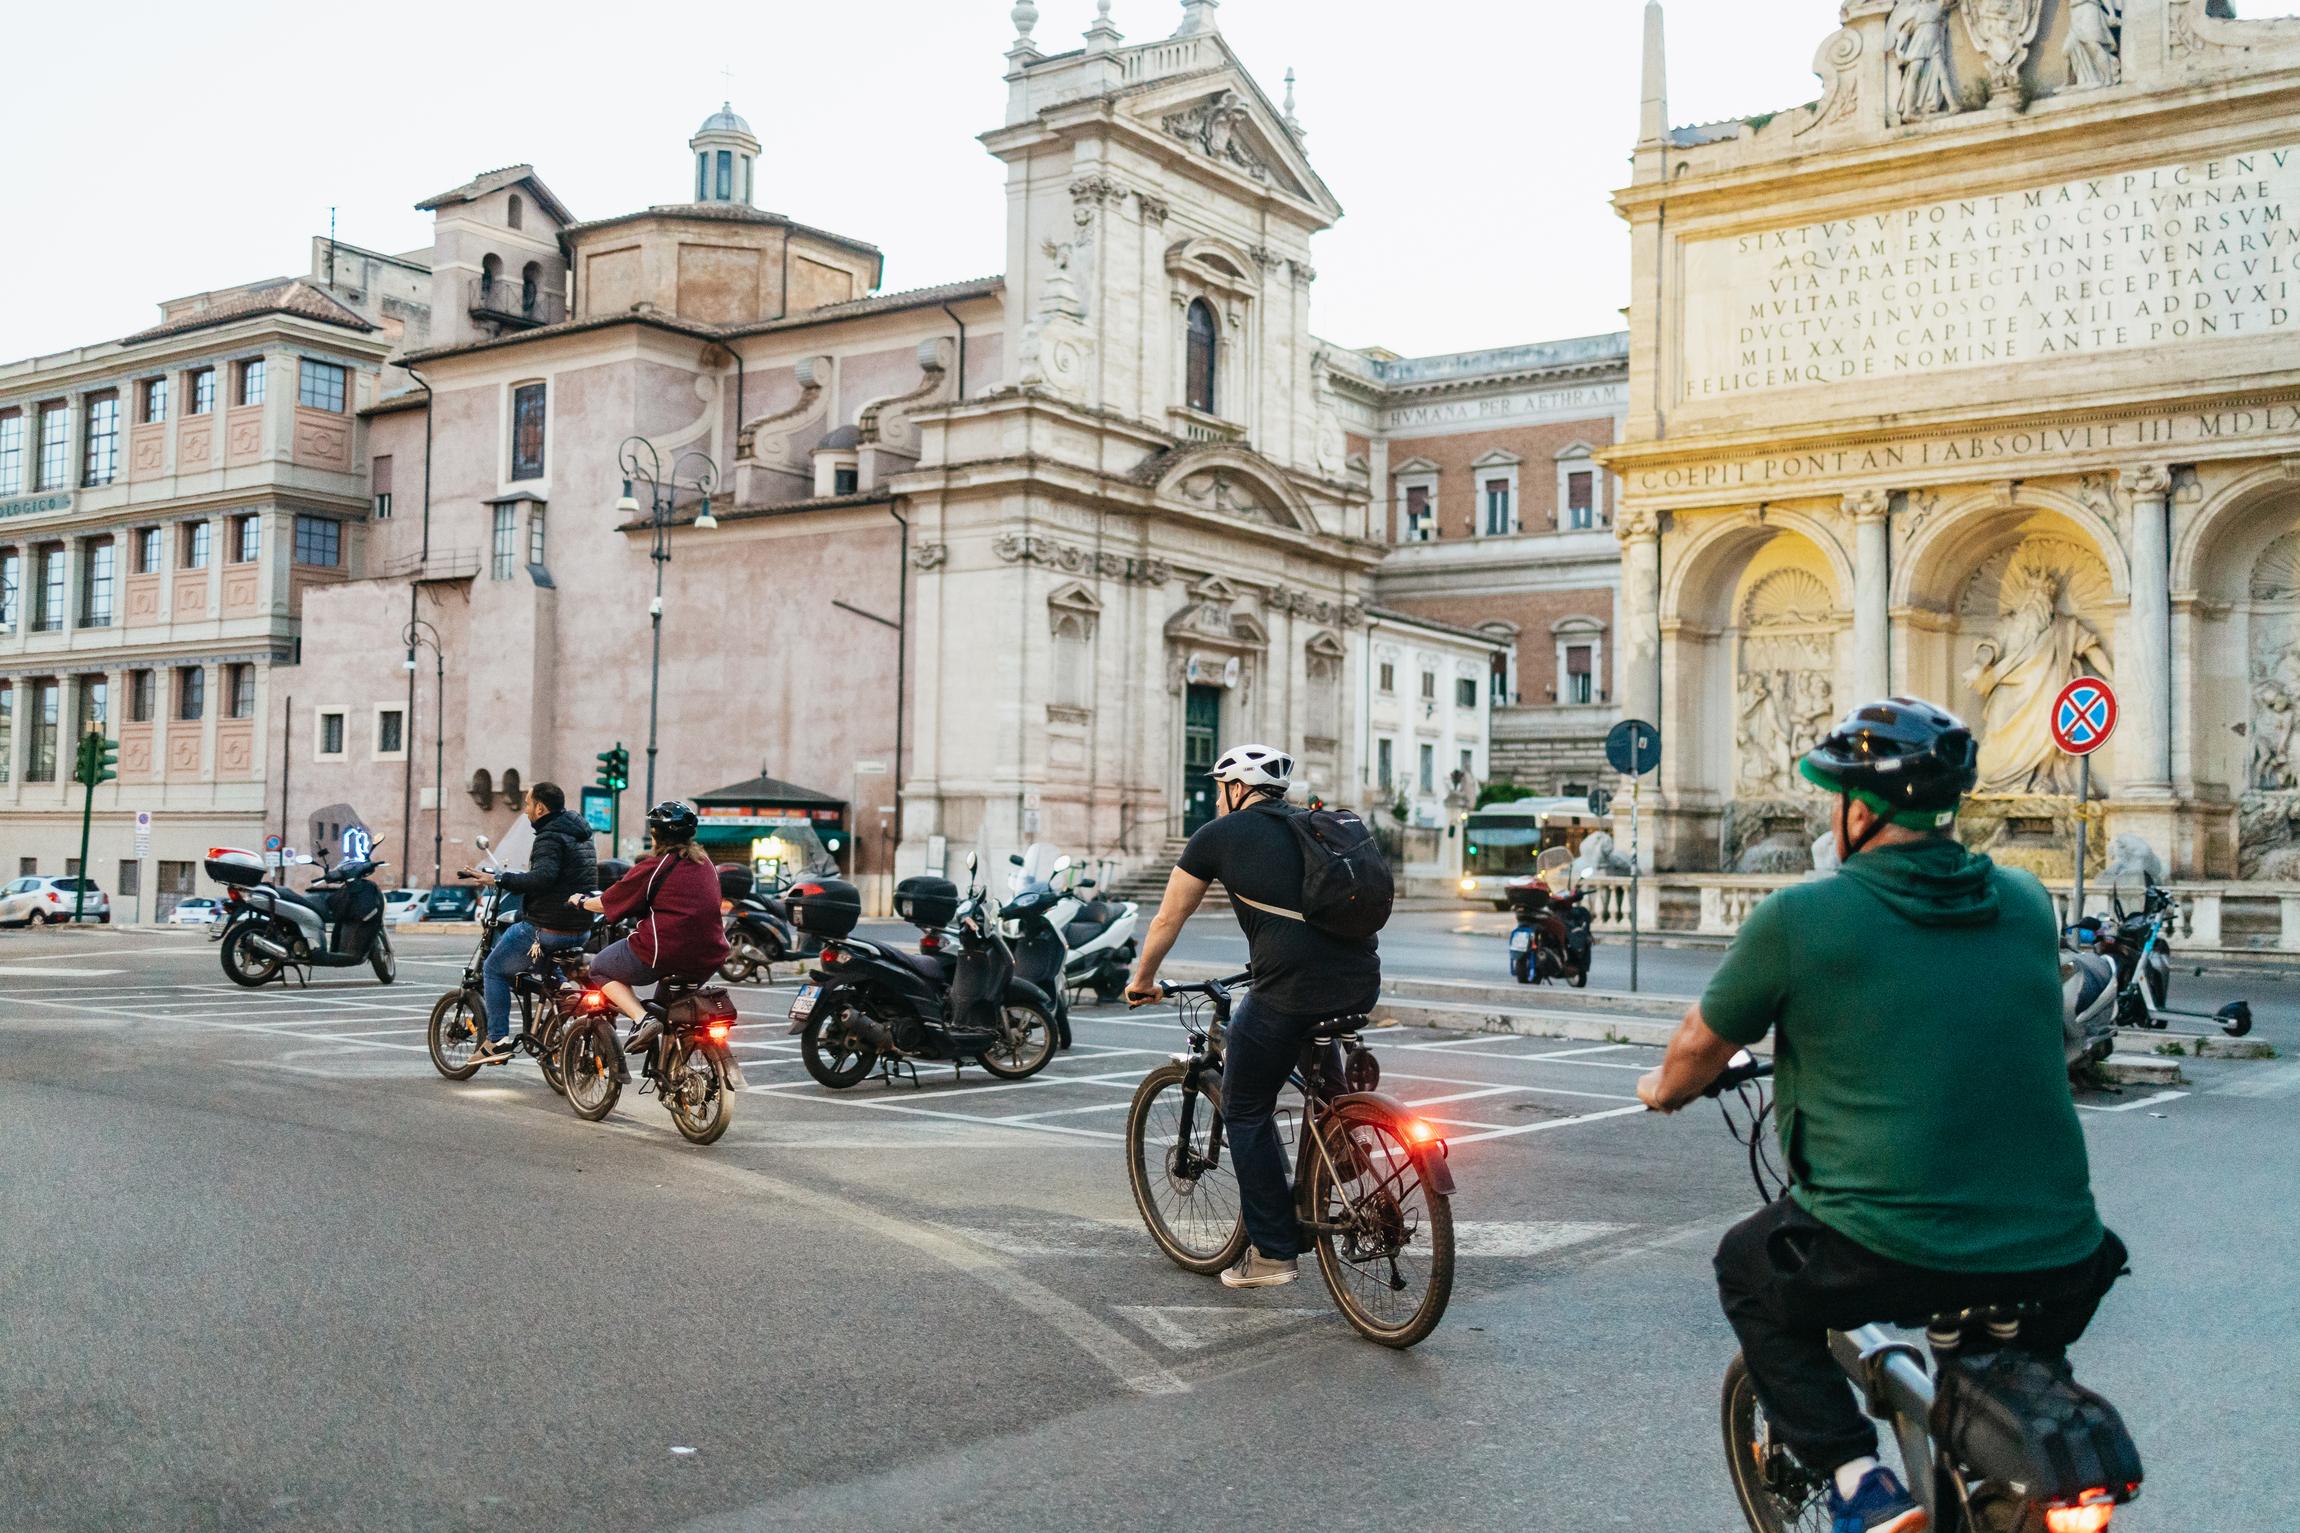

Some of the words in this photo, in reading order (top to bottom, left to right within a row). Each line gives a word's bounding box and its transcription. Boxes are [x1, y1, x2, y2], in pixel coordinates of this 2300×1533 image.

[1739, 220, 1856, 253] SIXTVS
[1875, 215, 1890, 230] V
[1907, 197, 2003, 227] PONT
[2024, 181, 2102, 208] MAX
[1770, 274, 1820, 293] VIA
[1840, 245, 2001, 284] PRAENEST
[2021, 204, 2282, 258] SINISTRORSVM
[1779, 241, 1885, 269] AQVAM
[1909, 231, 1942, 250] EX
[1962, 214, 2051, 242] AGRO
[2077, 181, 2269, 224] COLVMNAE
[1750, 291, 1860, 319] MVLTAR
[1882, 254, 2114, 302] COLLECTIONE
[2139, 228, 2300, 265] VENARVM
[1686, 364, 1830, 396] FELICEMQ
[1841, 356, 1874, 376] DE
[1894, 340, 2016, 370] NOMINE
[2040, 326, 2127, 352] ANTE
[2150, 312, 2253, 340] PONT
[1740, 317, 1832, 344] DVCTV
[1852, 294, 1996, 328] SINVOSO
[2018, 290, 2033, 306] A
[1742, 346, 1792, 366] MIL
[1809, 340, 1844, 357] XX
[1862, 336, 1877, 350] A
[1896, 316, 2018, 345] CAPITE
[2039, 301, 2112, 329] XXII
[2136, 280, 2300, 317] ADDVXI
[1391, 405, 1468, 426] HVMANA
[1480, 399, 1511, 416] PER
[1524, 387, 1618, 410] AETHRAM
[1642, 462, 1747, 489] COEPIT
[1765, 451, 1847, 479] PONT
[1861, 446, 1904, 469] AN
[1922, 443, 1928, 462] I
[1944, 424, 2118, 460] ABSOLVIT
[2138, 419, 2174, 442] III
